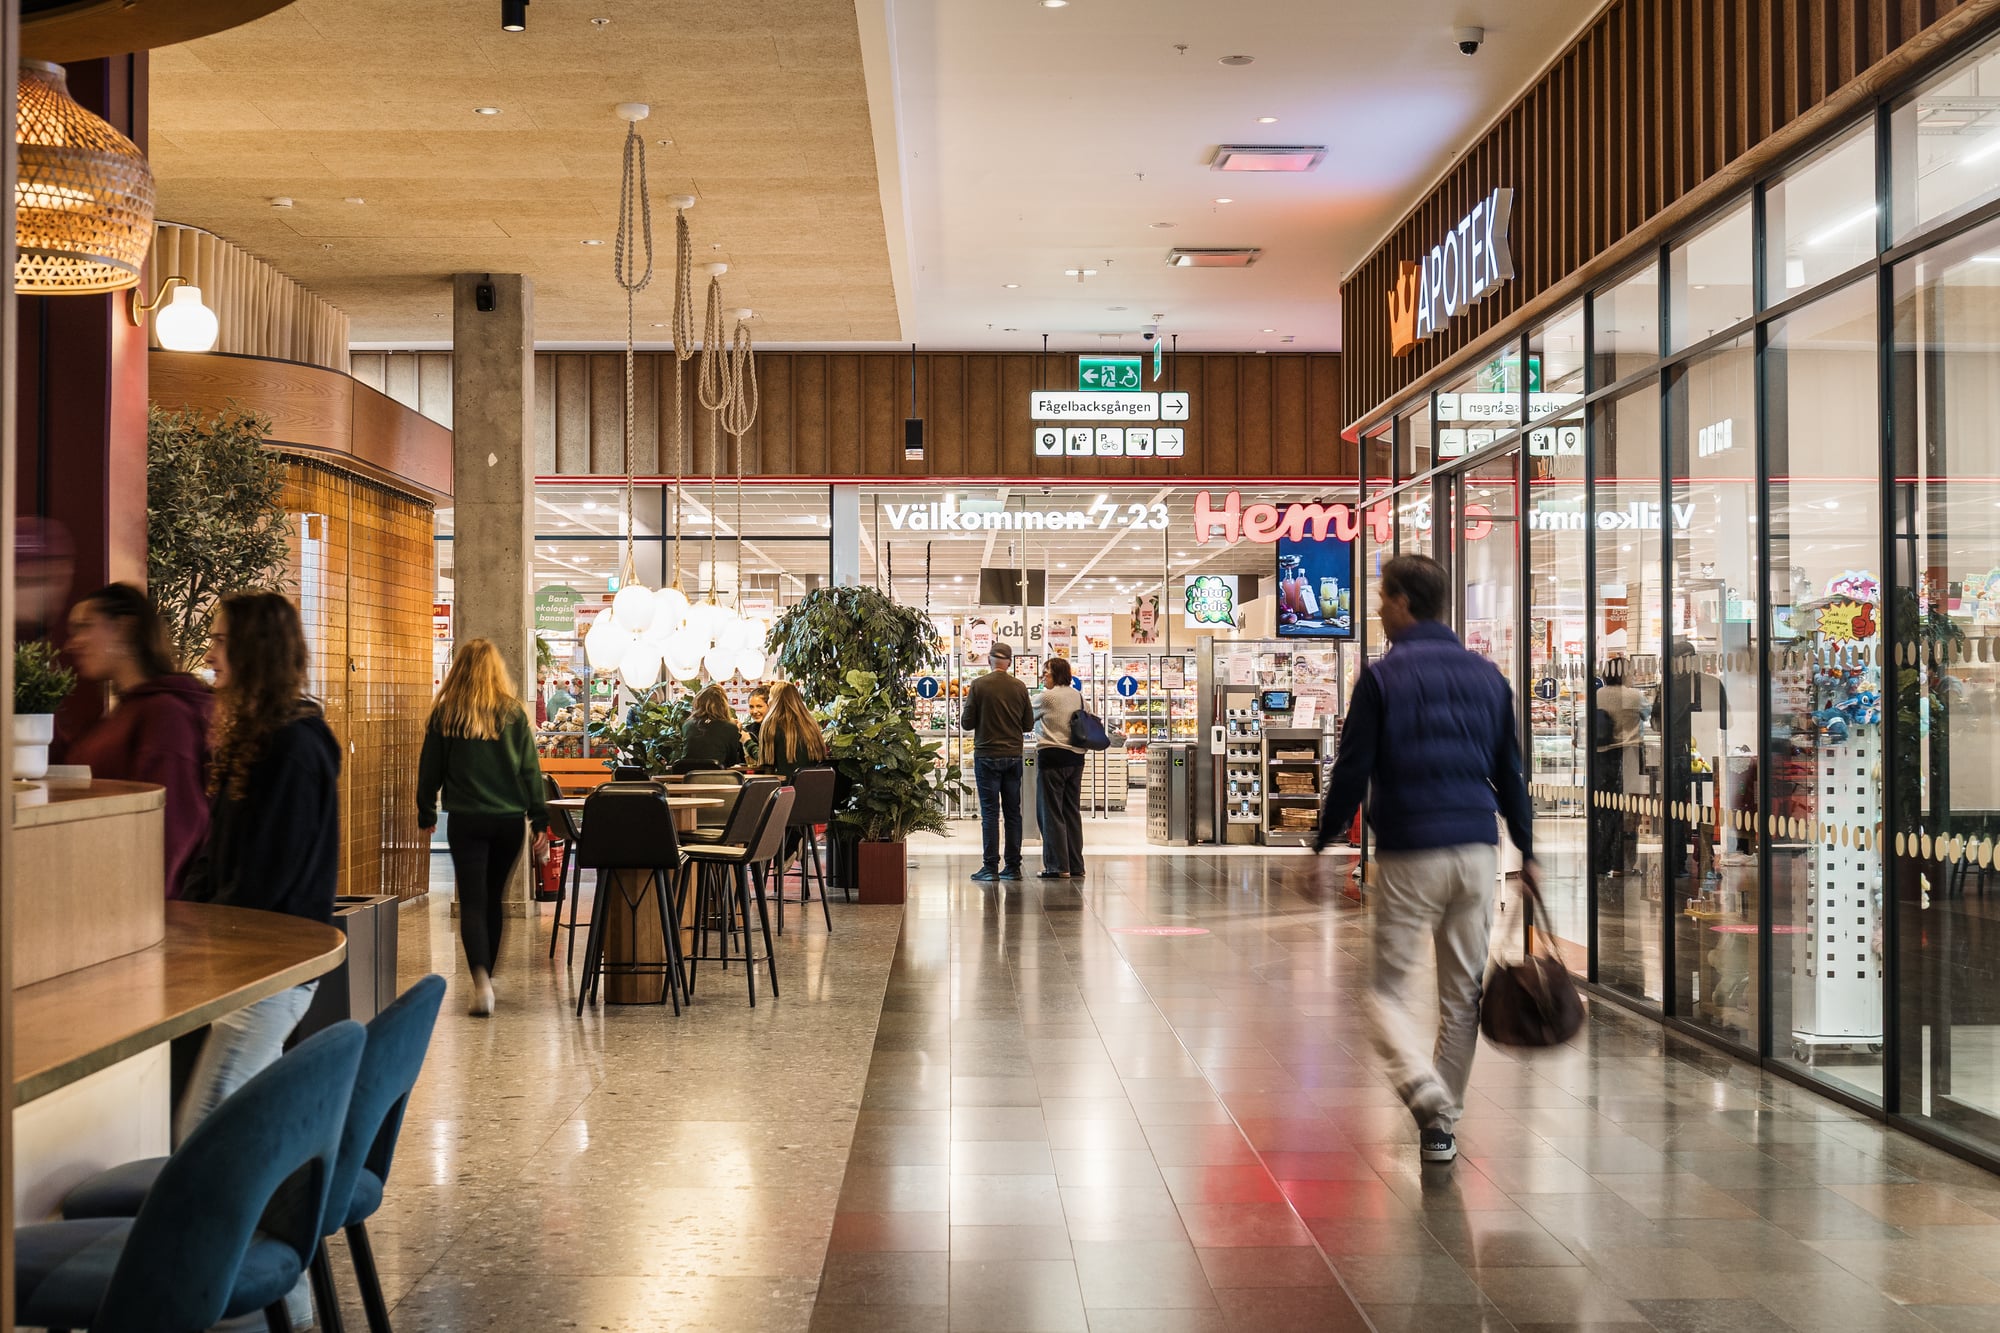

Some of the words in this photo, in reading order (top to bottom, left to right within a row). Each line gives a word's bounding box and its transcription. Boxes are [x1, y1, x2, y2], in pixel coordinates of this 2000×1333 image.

[1417, 187, 1512, 339] APOTEK
[1039, 400, 1151, 415] Fågelbacksgången
[884, 502, 1085, 530] Välkommen
[1096, 503, 1169, 530] 7-23
[1192, 587, 1228, 597] Natur
[536, 604, 575, 614] ekologisk
[1192, 600, 1228, 611] Godis
[539, 614, 574, 622] bananer
[999, 621, 1024, 637] ch
